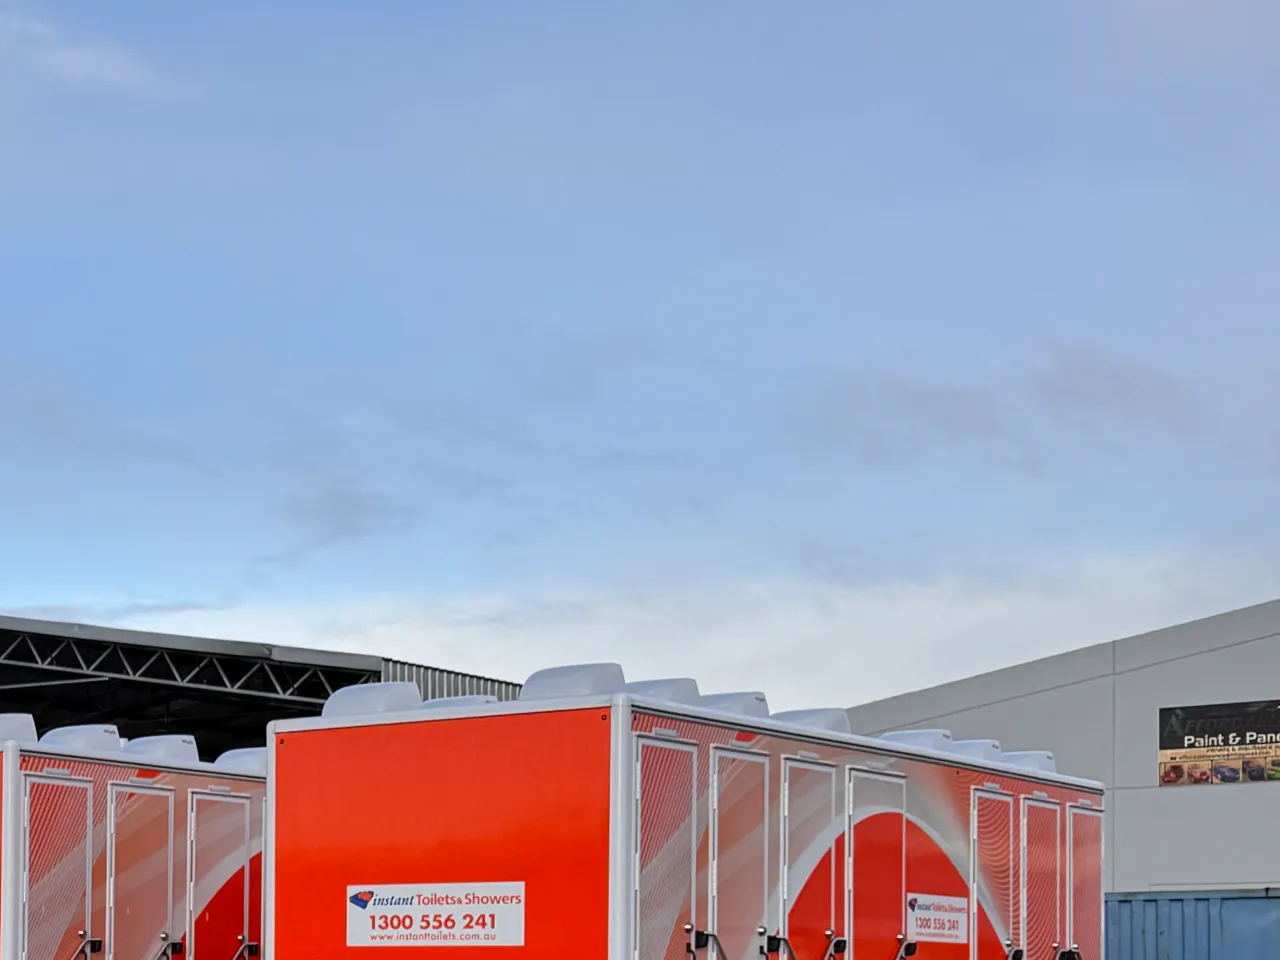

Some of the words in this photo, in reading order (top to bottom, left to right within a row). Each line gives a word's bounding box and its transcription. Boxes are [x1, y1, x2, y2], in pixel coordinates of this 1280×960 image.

[1184, 734, 1224, 747] Paint
[1228, 732, 1241, 745] &
[373, 894, 414, 906] instant
[465, 892, 522, 905] Showers
[370, 914, 413, 930] 1300
[420, 914, 456, 930] 556
[462, 913, 496, 929] 241
[915, 916, 931, 929] 1300
[933, 918, 945, 930] 556
[947, 919, 959, 931] 241
[370, 931, 496, 941] www.instanttoilets.com.au
